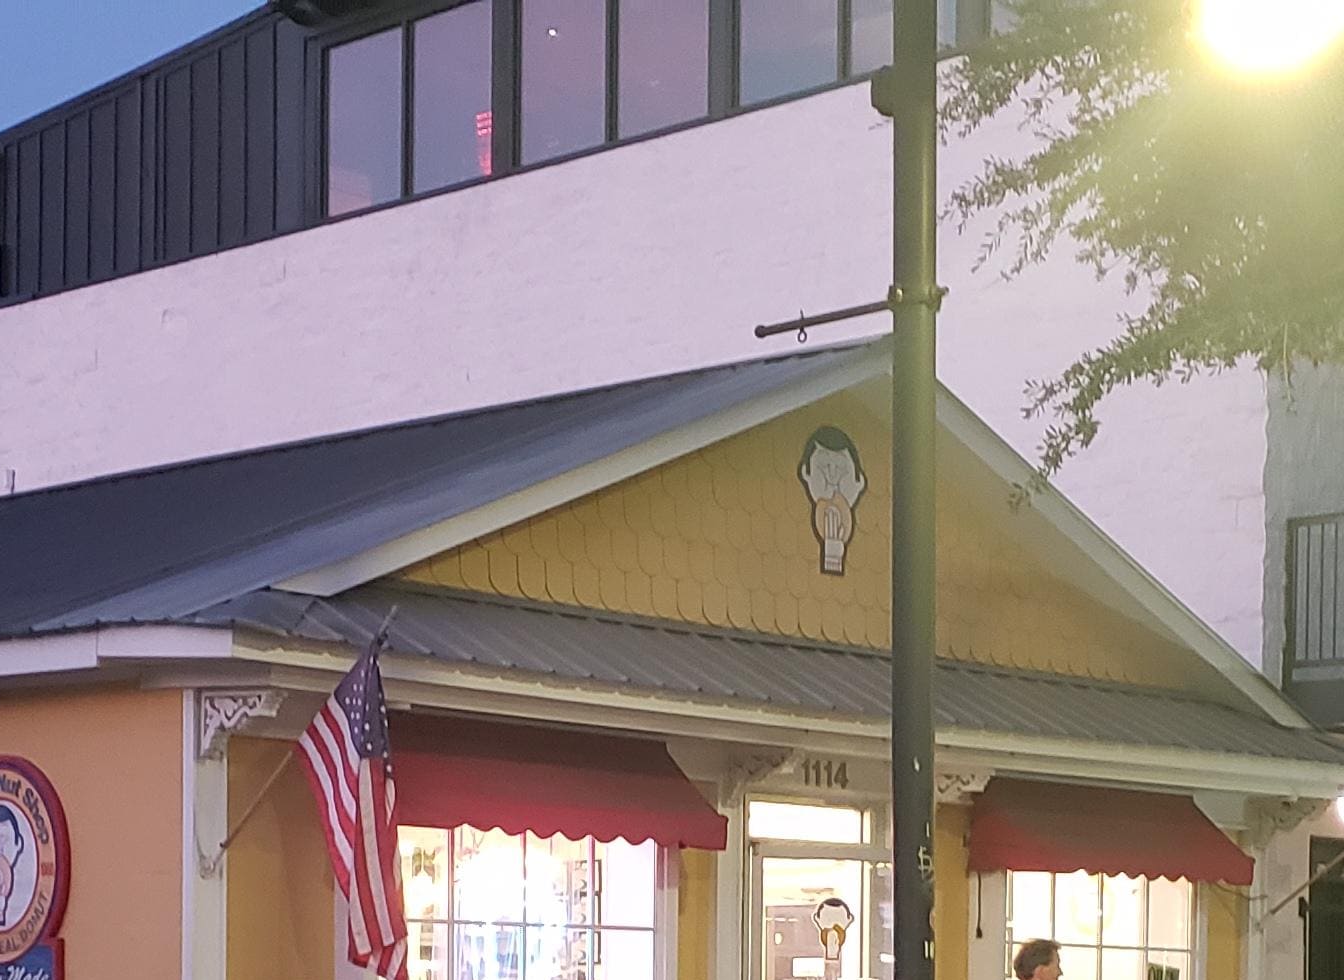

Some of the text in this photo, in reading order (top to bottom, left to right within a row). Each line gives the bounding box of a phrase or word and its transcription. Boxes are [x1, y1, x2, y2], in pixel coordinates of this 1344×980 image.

[801, 758, 849, 790] 1114
[22, 787, 50, 845] Shop
[19, 891, 49, 942] DONUT
